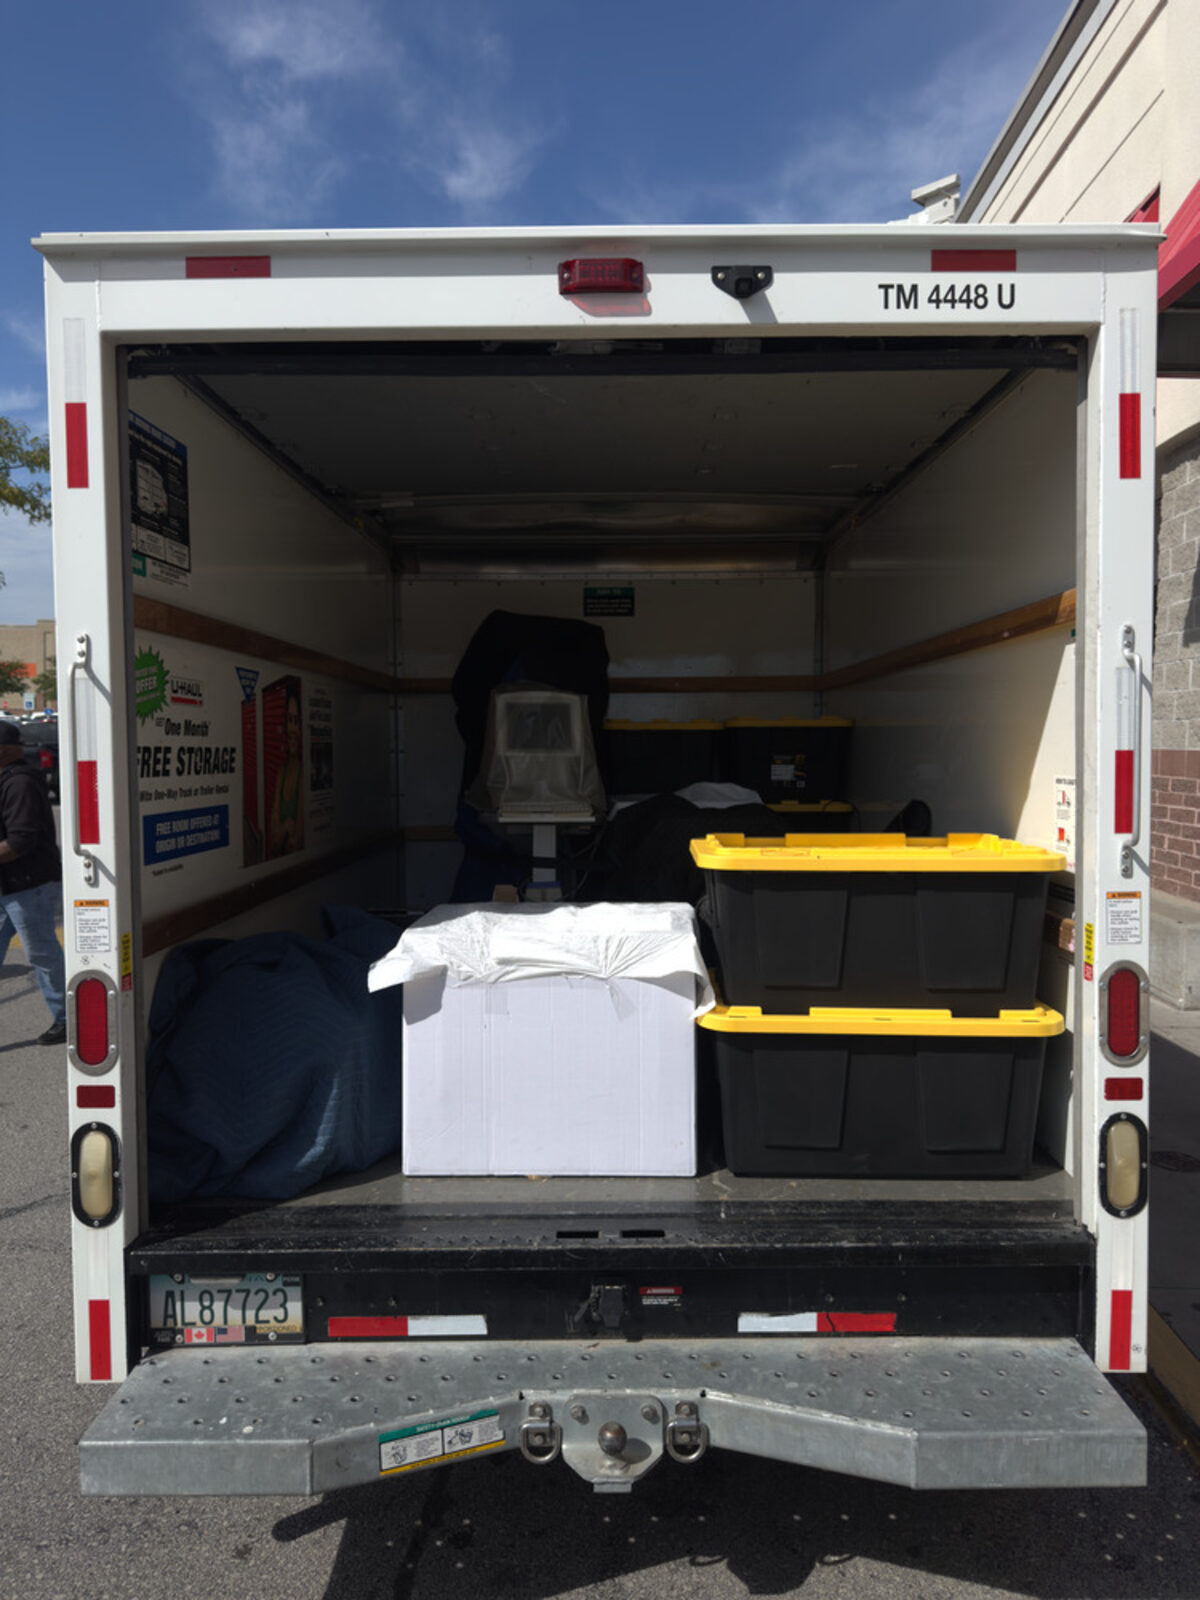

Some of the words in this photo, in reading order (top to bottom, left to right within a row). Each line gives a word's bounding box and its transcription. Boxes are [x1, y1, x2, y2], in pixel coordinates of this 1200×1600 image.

[878, 284, 918, 309] TM
[928, 284, 988, 309] 4448
[997, 284, 1015, 309] U
[164, 718, 181, 737] One
[176, 746, 236, 776] STORAGE
[163, 1288, 288, 1327] AL87723
